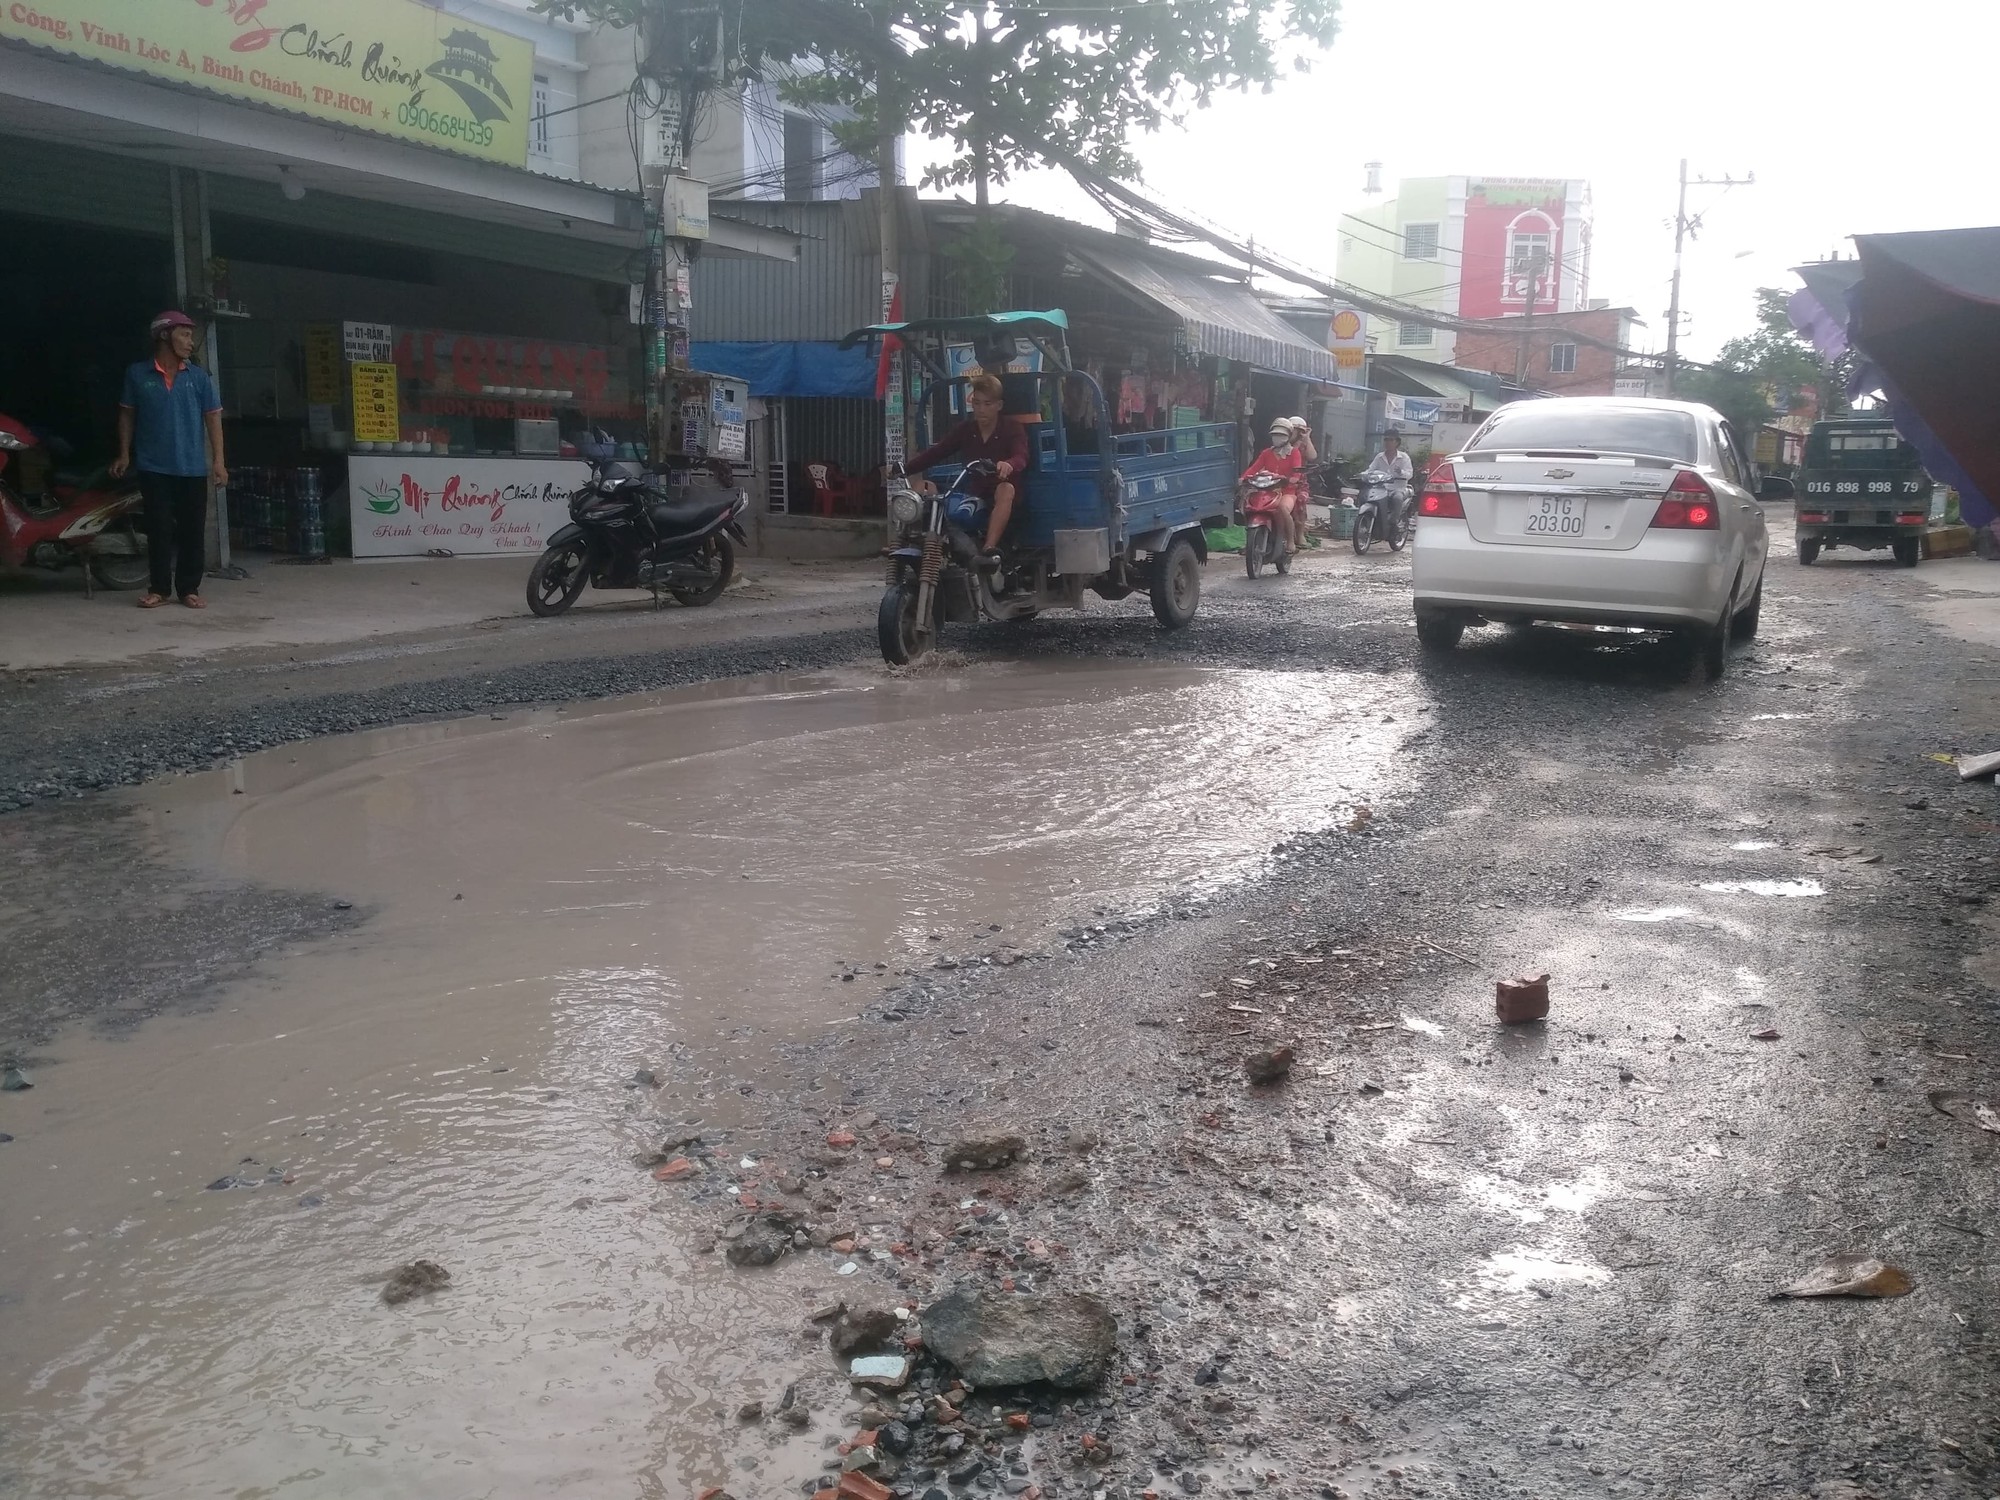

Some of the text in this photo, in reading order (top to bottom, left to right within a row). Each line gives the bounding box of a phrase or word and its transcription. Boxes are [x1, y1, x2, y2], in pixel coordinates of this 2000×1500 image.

[10, 2, 73, 41] Công,
[137, 37, 170, 64] Lộc
[176, 49, 196, 73] A,
[312, 86, 373, 116] TP.HCM
[1807, 482, 1919, 493] 016 898 998 79
[441, 475, 506, 522] Quảng
[1541, 498, 1572, 515] 51G
[1527, 515, 1581, 533] 203.00
